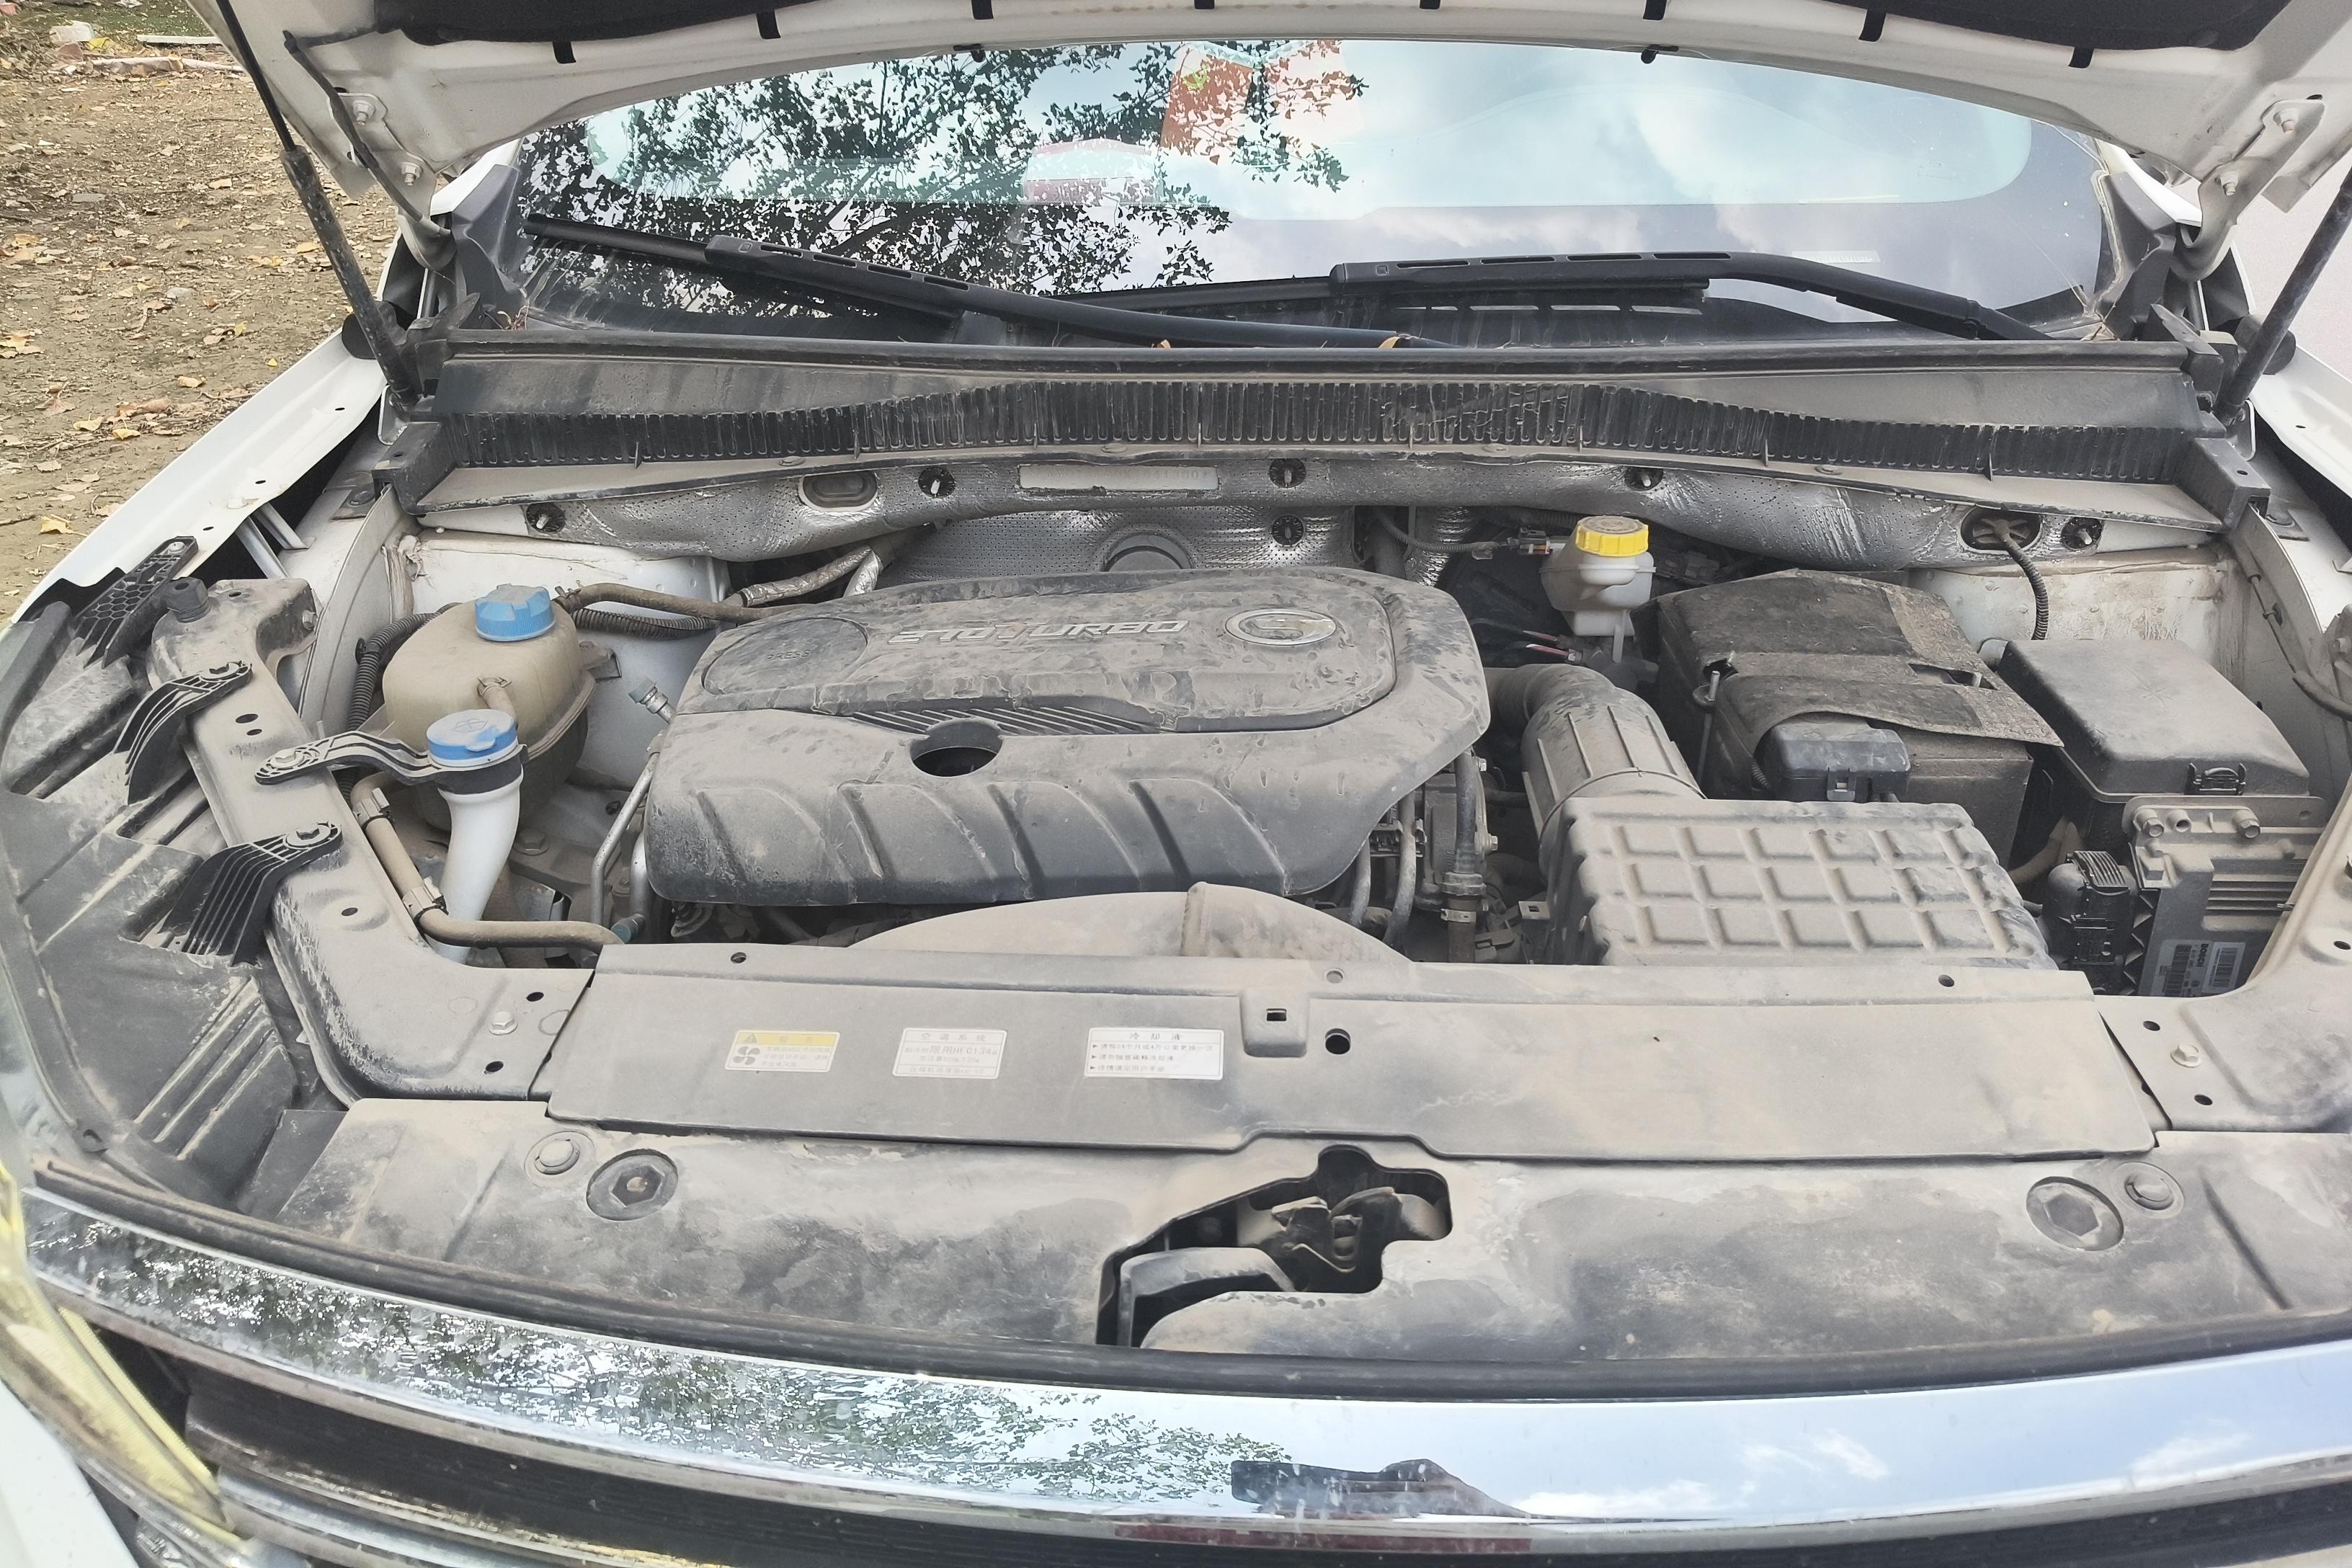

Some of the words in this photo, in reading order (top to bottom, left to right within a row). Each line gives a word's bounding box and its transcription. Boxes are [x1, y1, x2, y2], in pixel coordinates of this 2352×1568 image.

[2196, 943, 2209, 967] BOSCH
[922, 1033, 986, 1042] 空调系统
[1130, 1032, 1180, 1041] 冷却液
